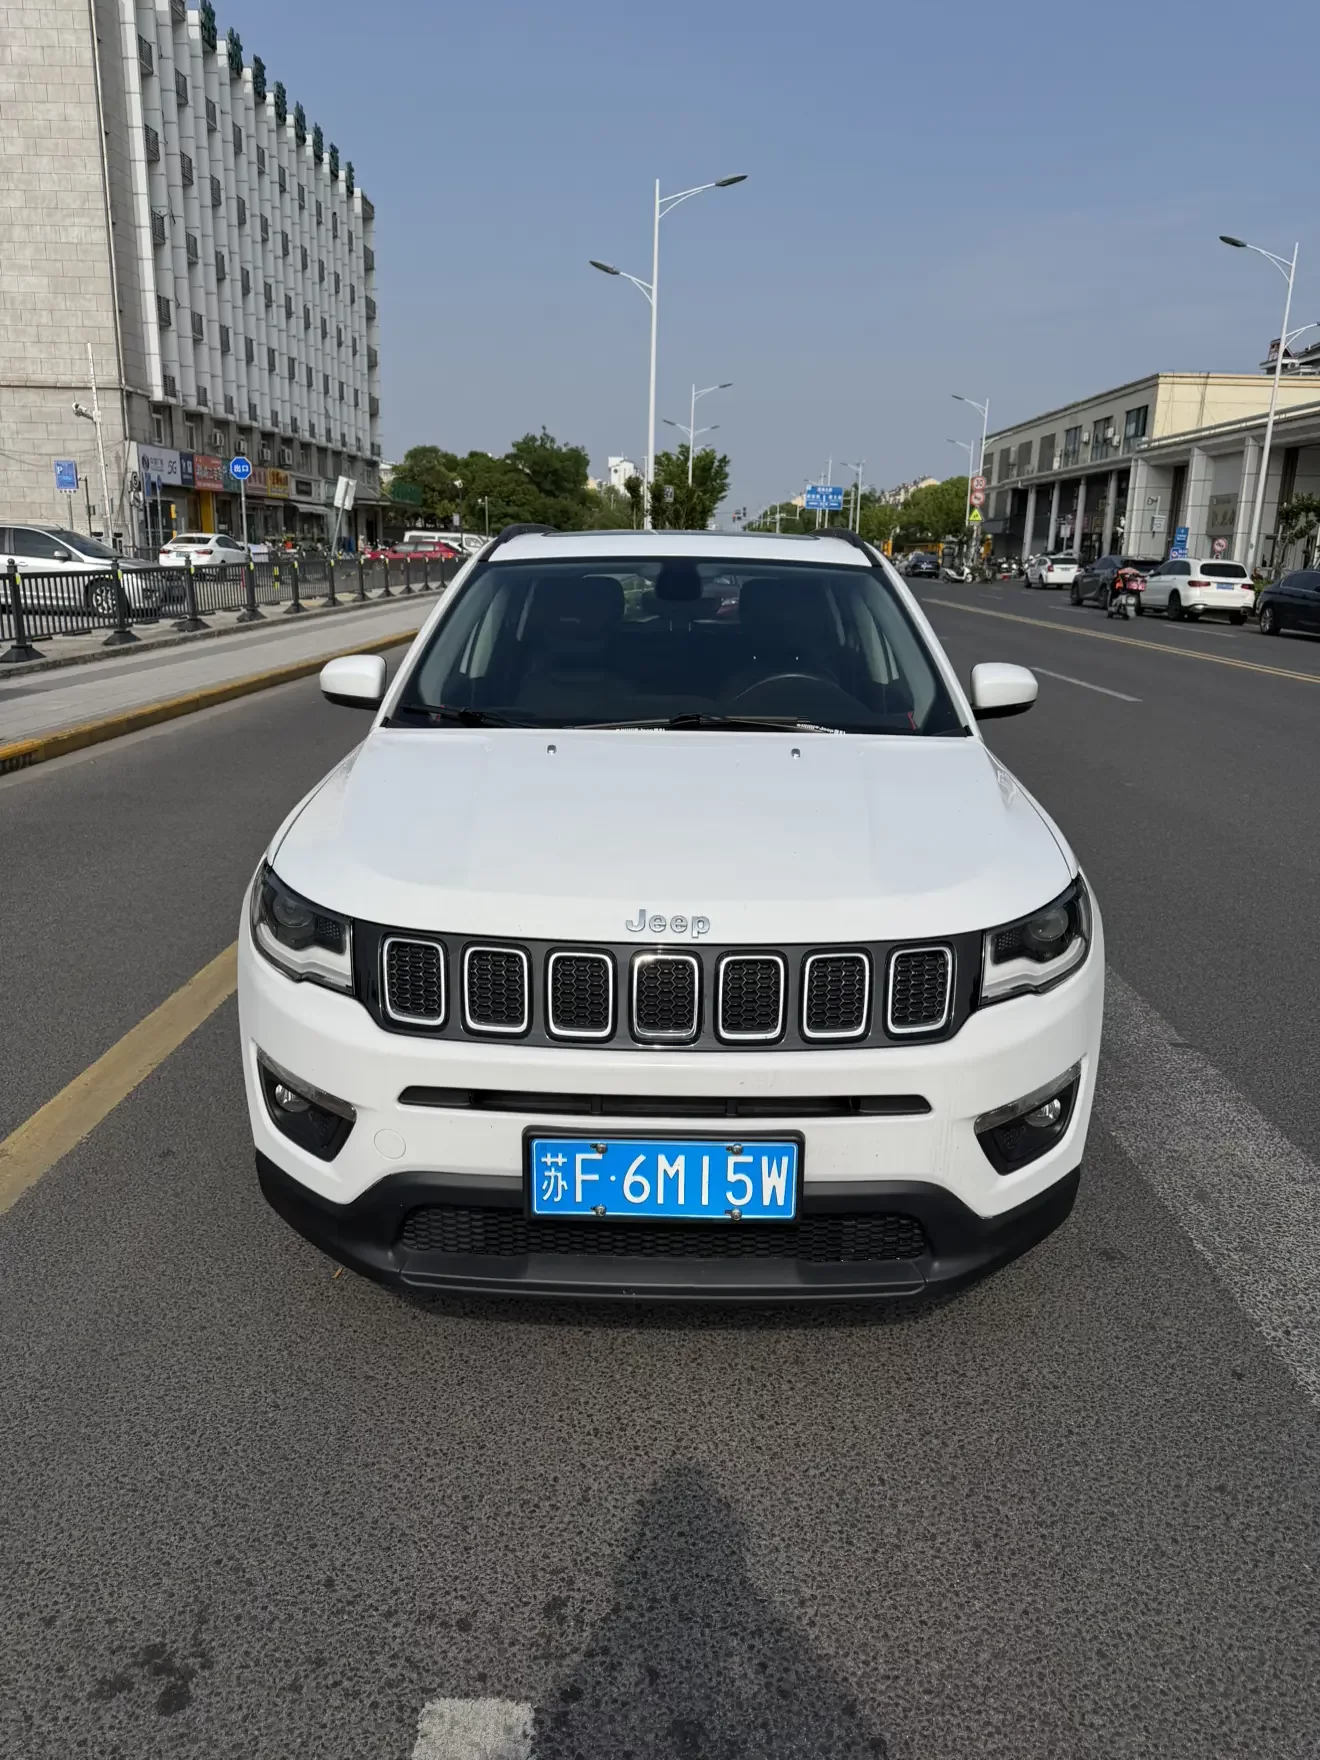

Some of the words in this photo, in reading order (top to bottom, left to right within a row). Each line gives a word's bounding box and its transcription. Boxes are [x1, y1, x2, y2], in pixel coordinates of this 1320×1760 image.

[57, 467, 63, 475] P
[168, 459, 177, 475] 5G
[233, 464, 249, 473] 出口
[975, 479, 984, 487] 30
[625, 908, 711, 939] Jeep
